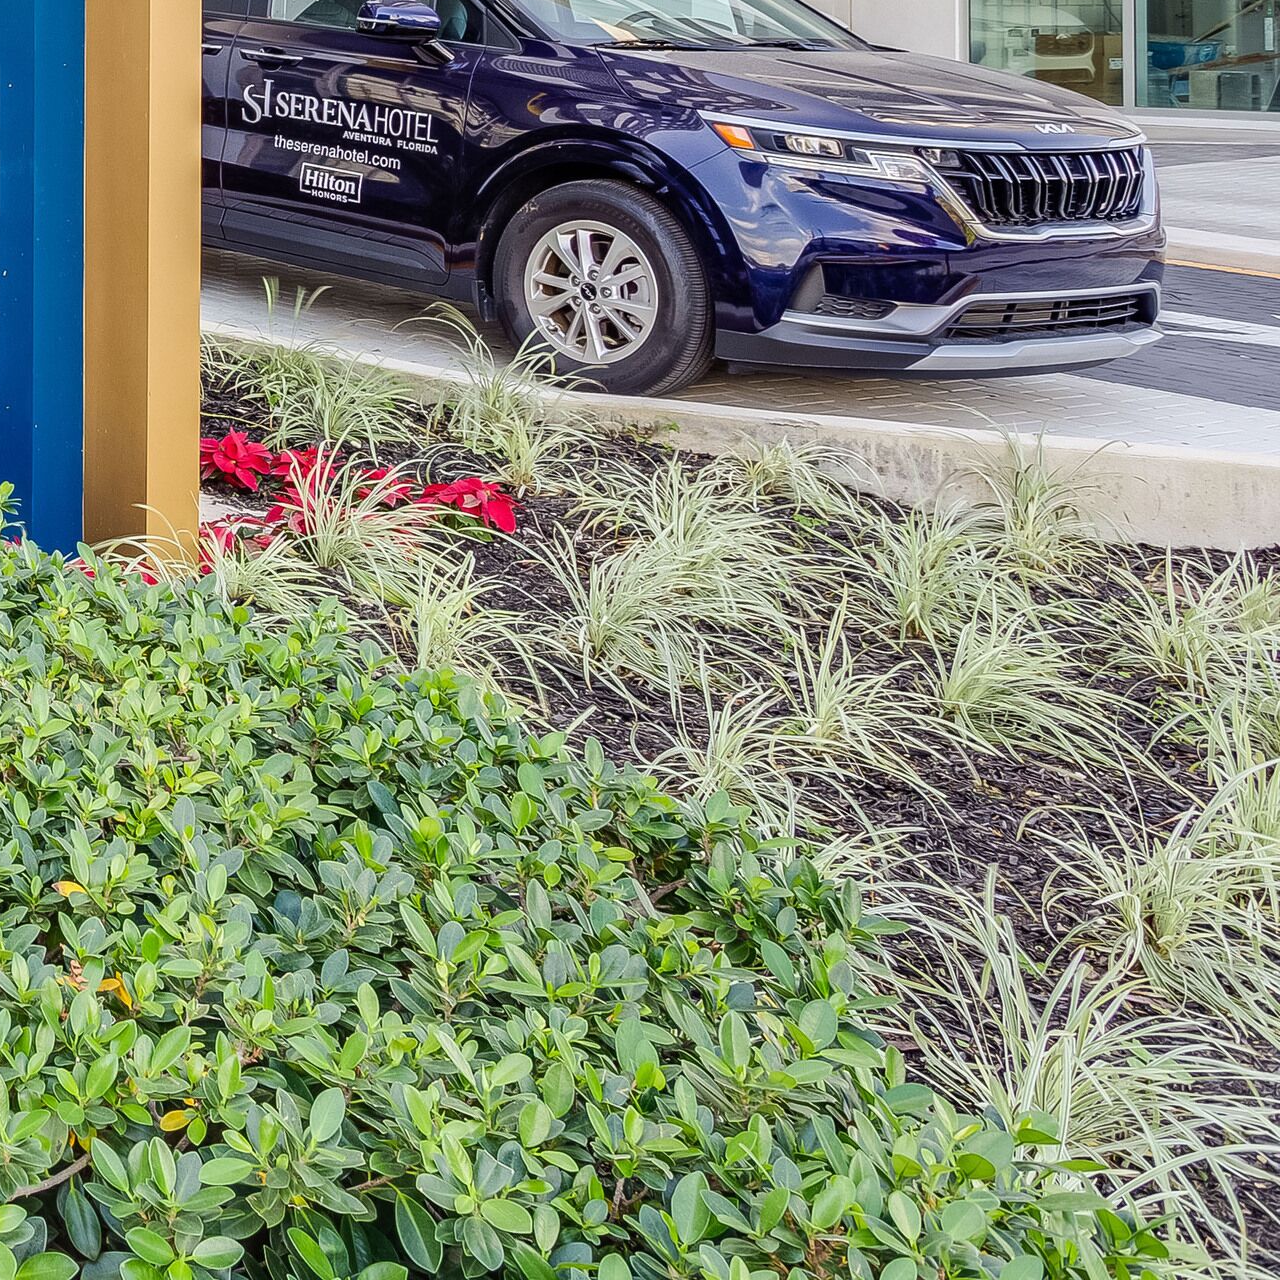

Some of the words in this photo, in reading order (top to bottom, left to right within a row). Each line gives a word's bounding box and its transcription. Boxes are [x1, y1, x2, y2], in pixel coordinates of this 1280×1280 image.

[274, 134, 401, 170] theserenahotel.com
[342, 130, 392, 147] AVENTURA
[396, 139, 438, 155] FLORIDA
[304, 169, 356, 195] Hilton
[311, 190, 348, 203] HONORS
